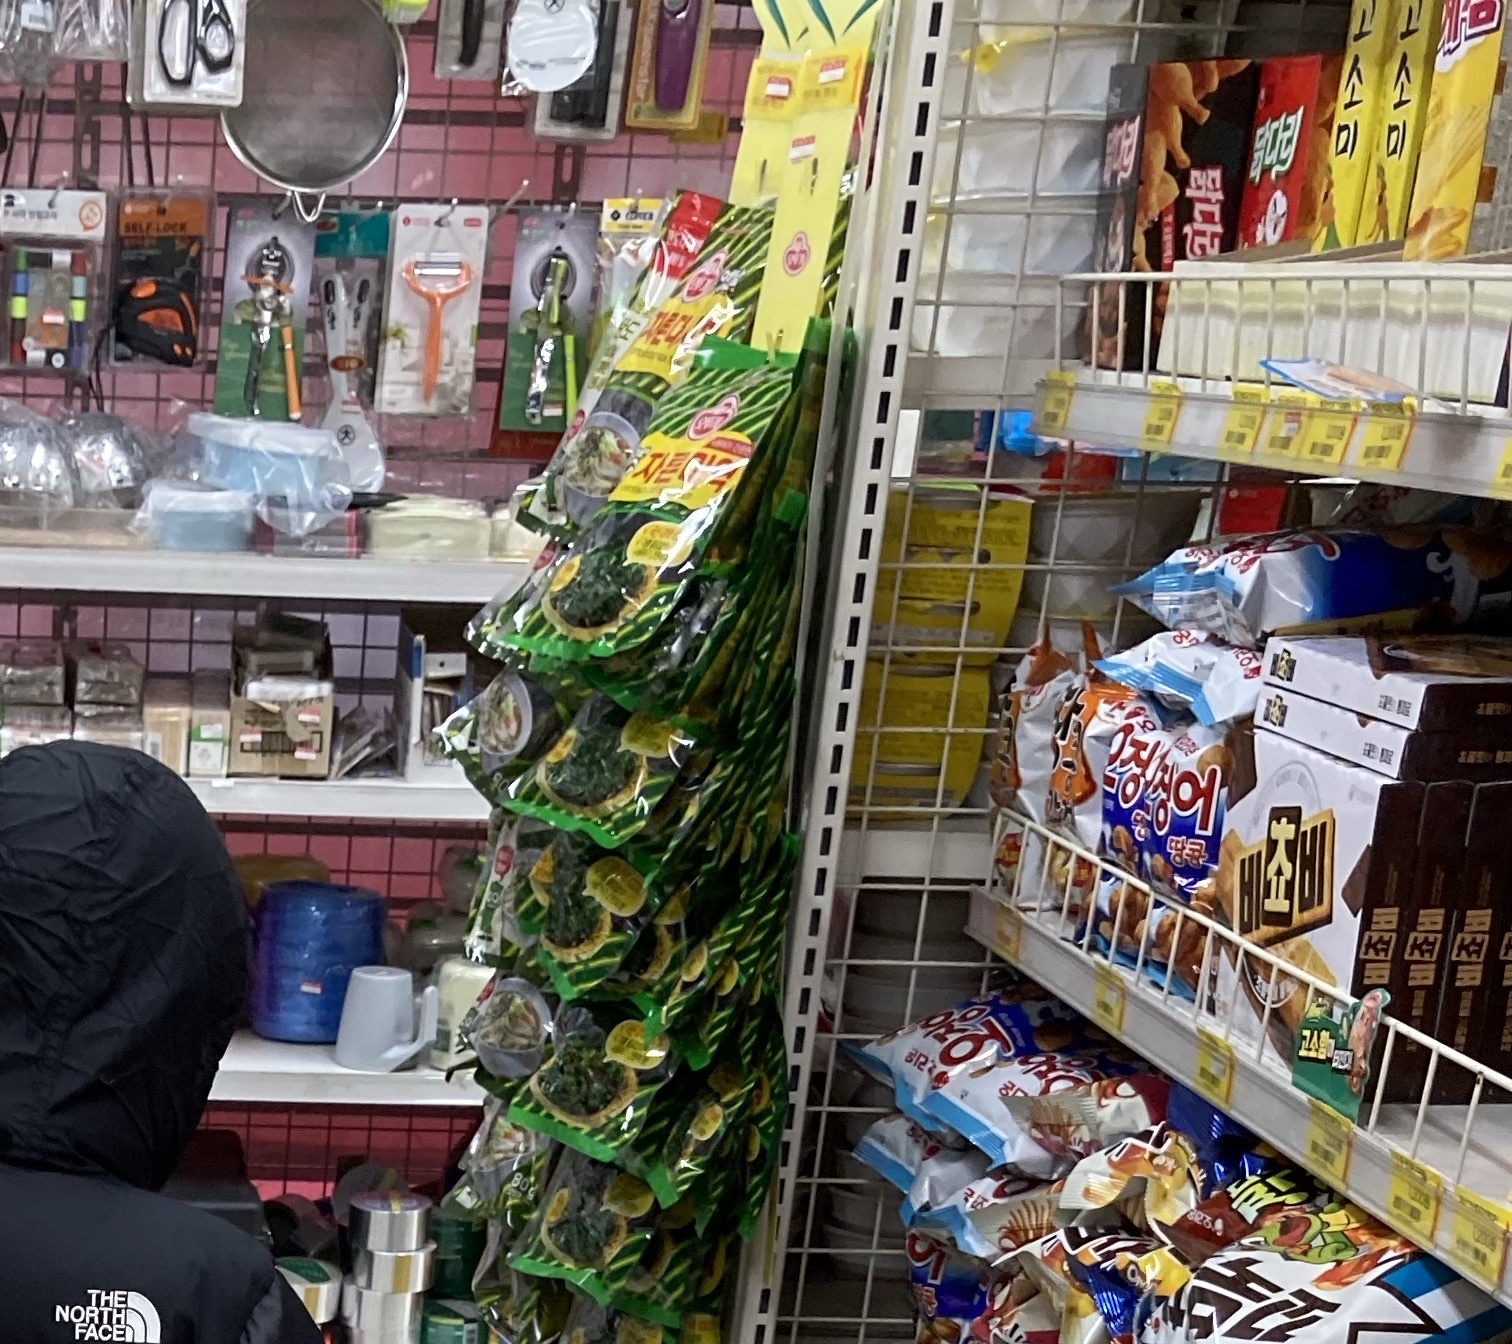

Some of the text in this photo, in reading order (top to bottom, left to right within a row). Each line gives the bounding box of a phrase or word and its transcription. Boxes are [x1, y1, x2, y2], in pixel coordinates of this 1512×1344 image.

[1248, 105, 1304, 187] 닭다리
[123, 221, 188, 234] SELF-LOCK
[1239, 817, 1328, 935] 비쵸비
[87, 1289, 127, 1308] THE
[55, 1305, 125, 1324] NORTH
[75, 1323, 126, 1341] FACE
